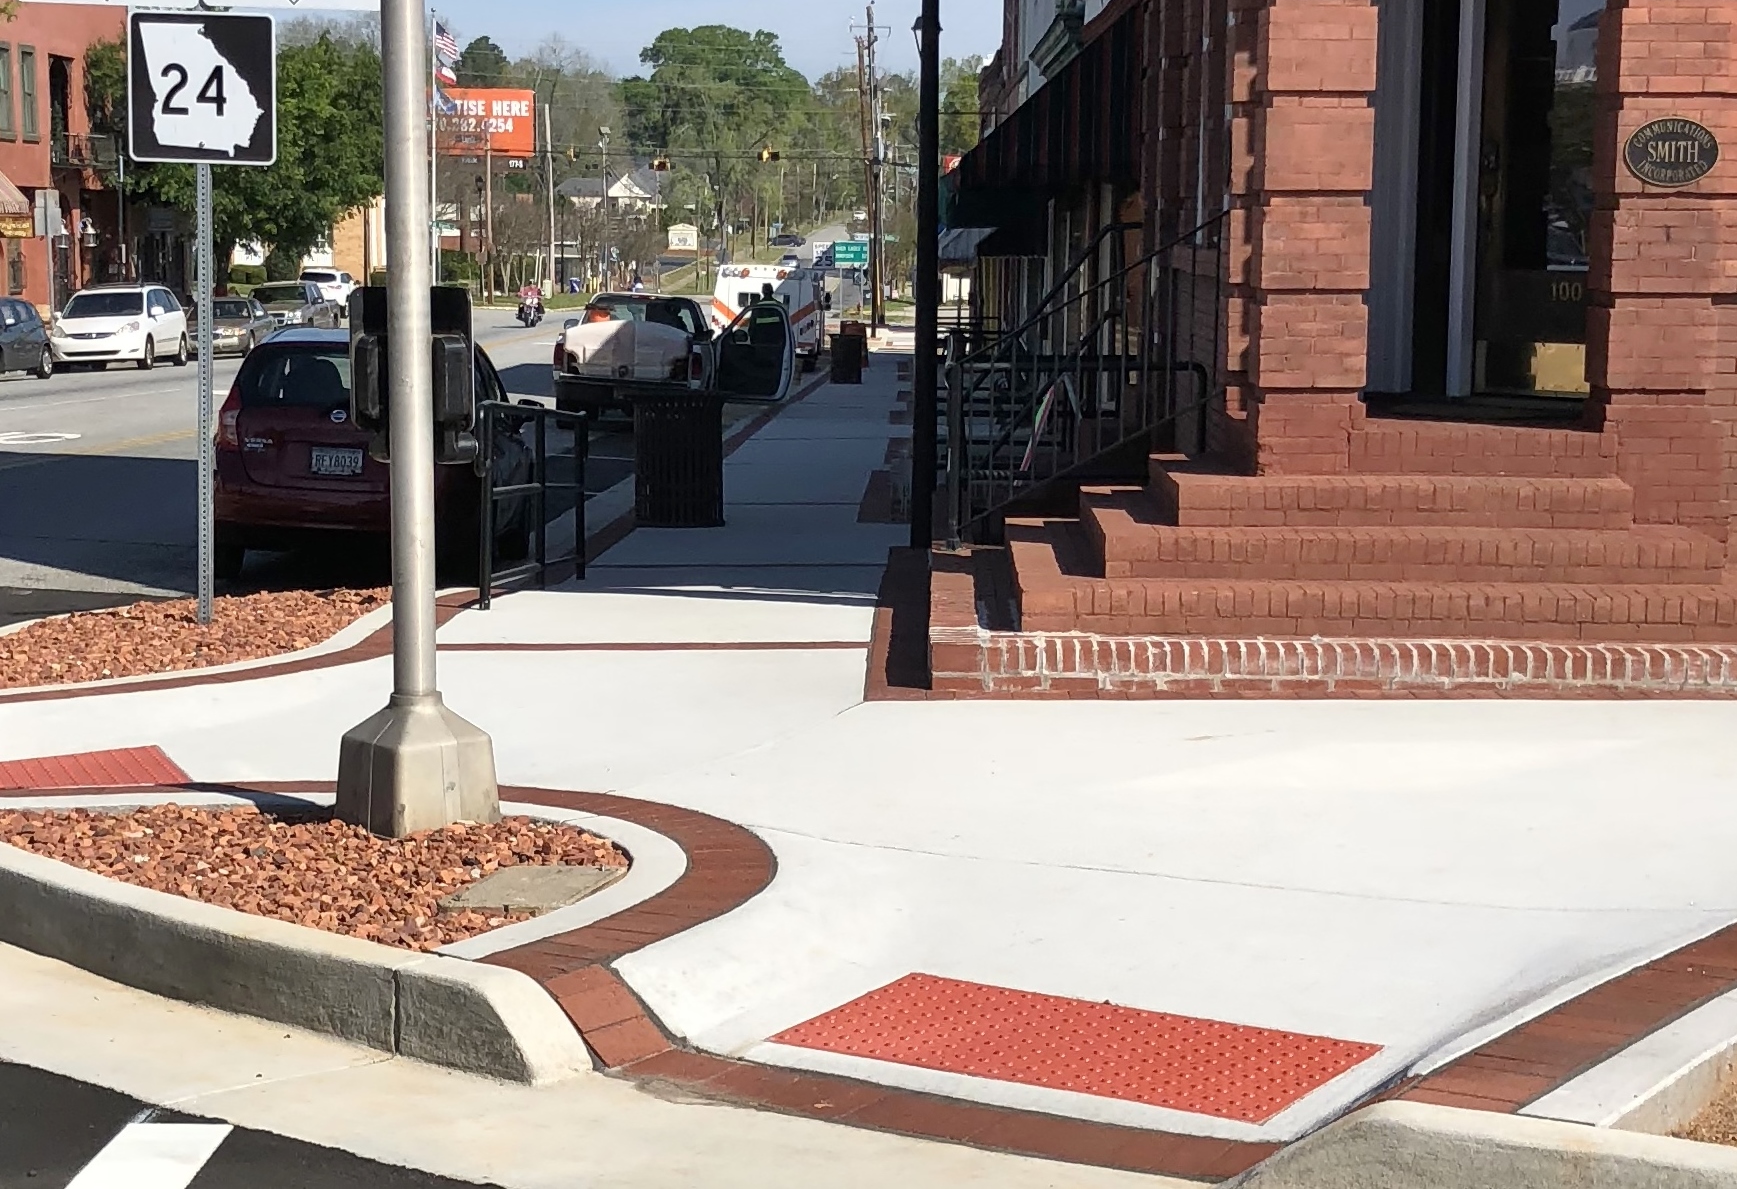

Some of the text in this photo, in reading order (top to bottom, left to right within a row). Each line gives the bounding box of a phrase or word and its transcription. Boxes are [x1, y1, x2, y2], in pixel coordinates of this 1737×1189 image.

[159, 62, 227, 117] 24
[491, 100, 530, 117] HERE
[1632, 120, 1713, 149] COMMUNICATIONS
[1647, 140, 1699, 163] SMITH
[1636, 159, 1709, 182] INCORPORATED
[815, 255, 833, 267] 25
[1550, 281, 1582, 301] 100
